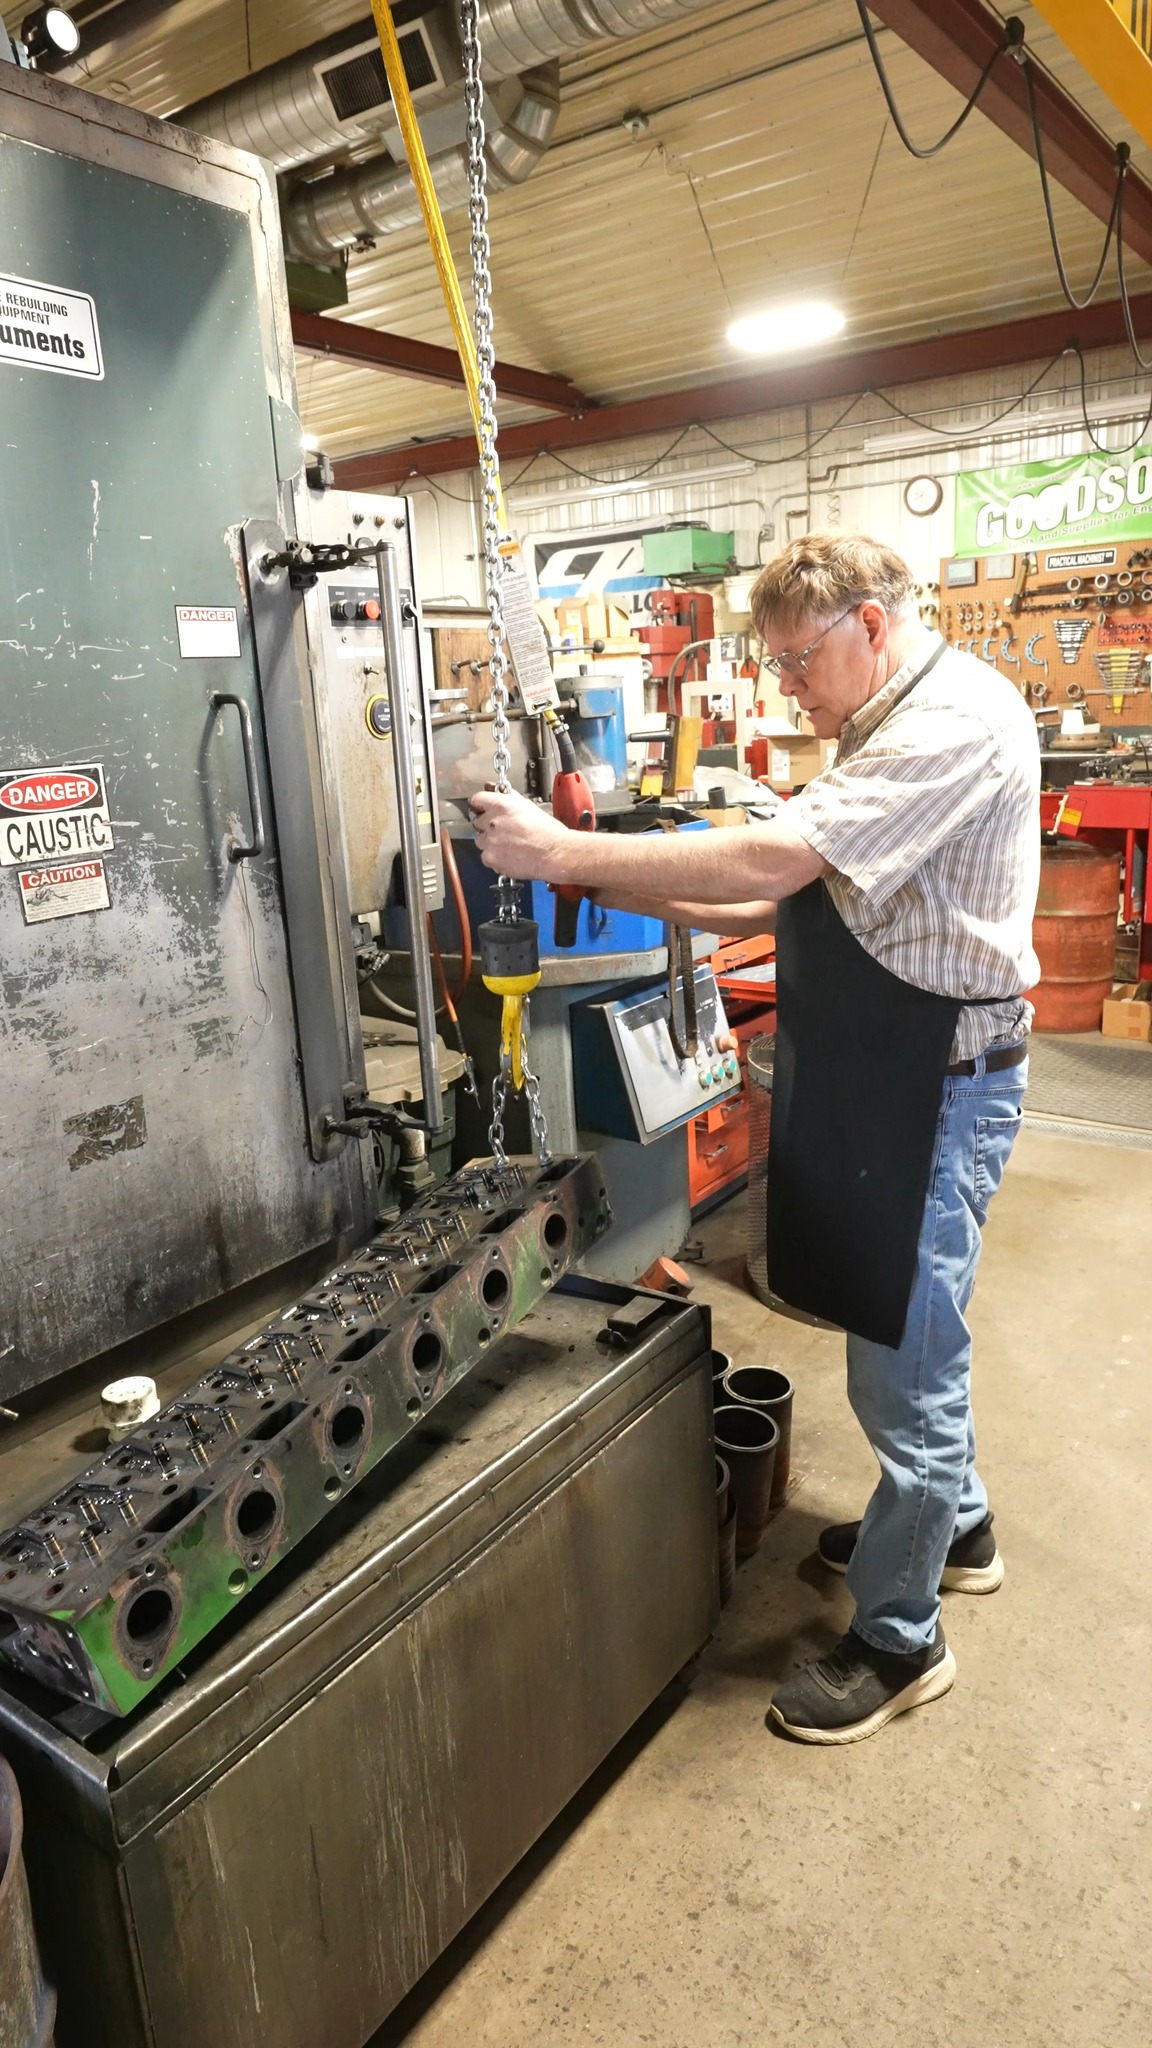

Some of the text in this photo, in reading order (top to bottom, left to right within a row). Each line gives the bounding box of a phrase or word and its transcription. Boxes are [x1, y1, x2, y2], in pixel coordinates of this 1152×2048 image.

[0, 305, 50, 325] UIPMENT
[6, 293, 68, 316] REBUILDING
[1062, 518, 1109, 535] Supplies
[1113, 510, 1129, 520] for
[180, 610, 233, 621] DANGER
[8, 780, 90, 805] DANGER
[7, 812, 106, 858] CAUSTIC
[28, 864, 96, 887] CAUTION
